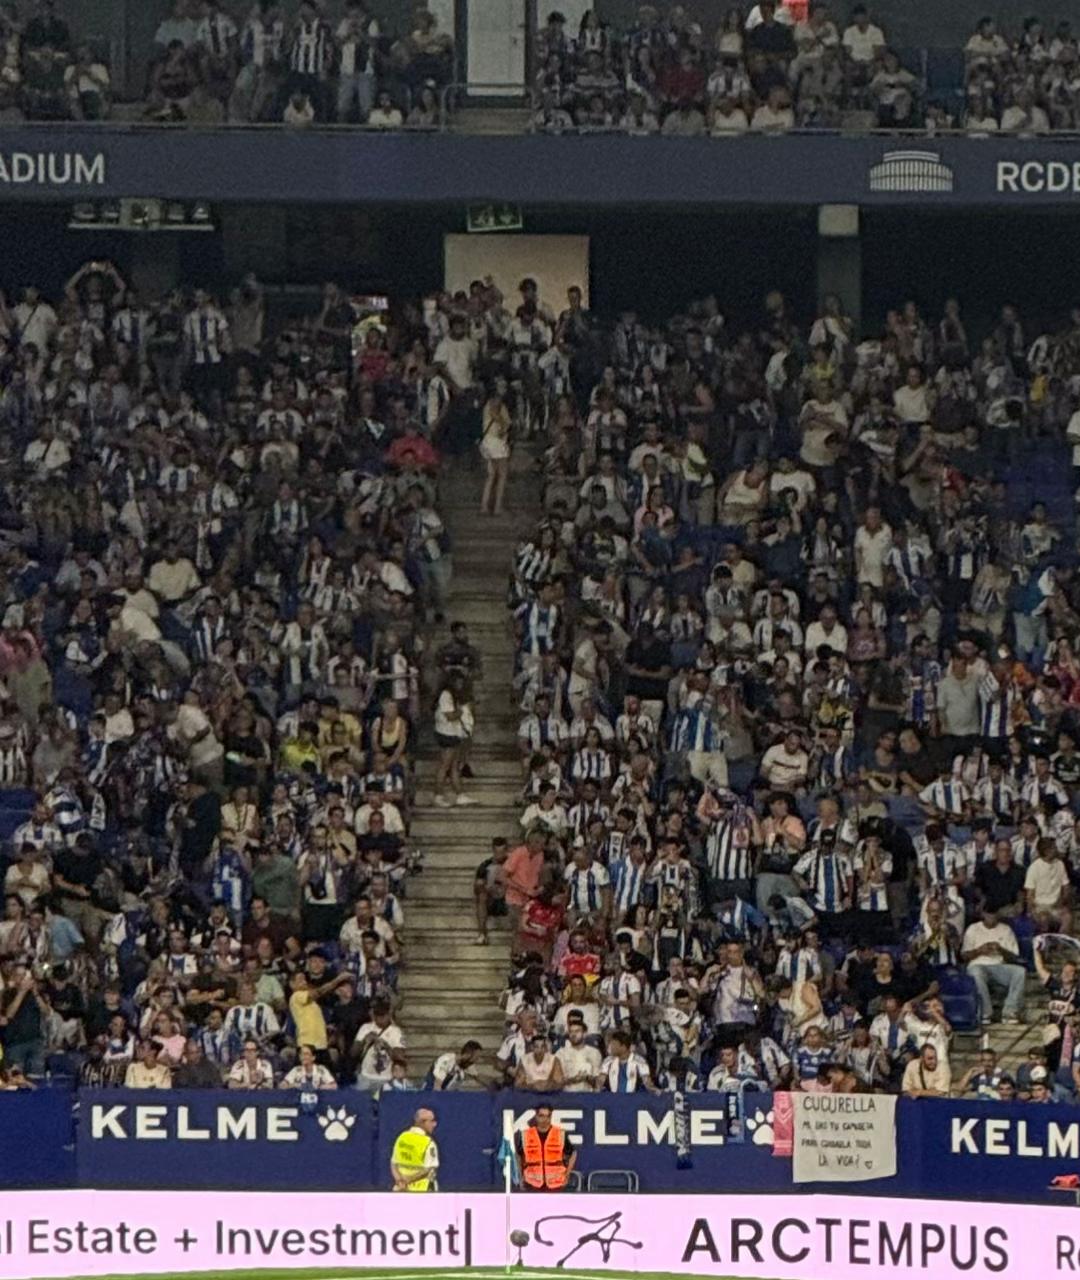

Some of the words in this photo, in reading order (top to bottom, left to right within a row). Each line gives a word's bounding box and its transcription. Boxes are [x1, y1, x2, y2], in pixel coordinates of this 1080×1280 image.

[803, 1095, 876, 1113] CUCURELLA
[92, 1106, 299, 1140] KELME
[29, 1219, 157, 1254] Estate
[216, 1220, 460, 1256] Investment
[681, 1217, 1009, 1272] ARCTEMPUS
